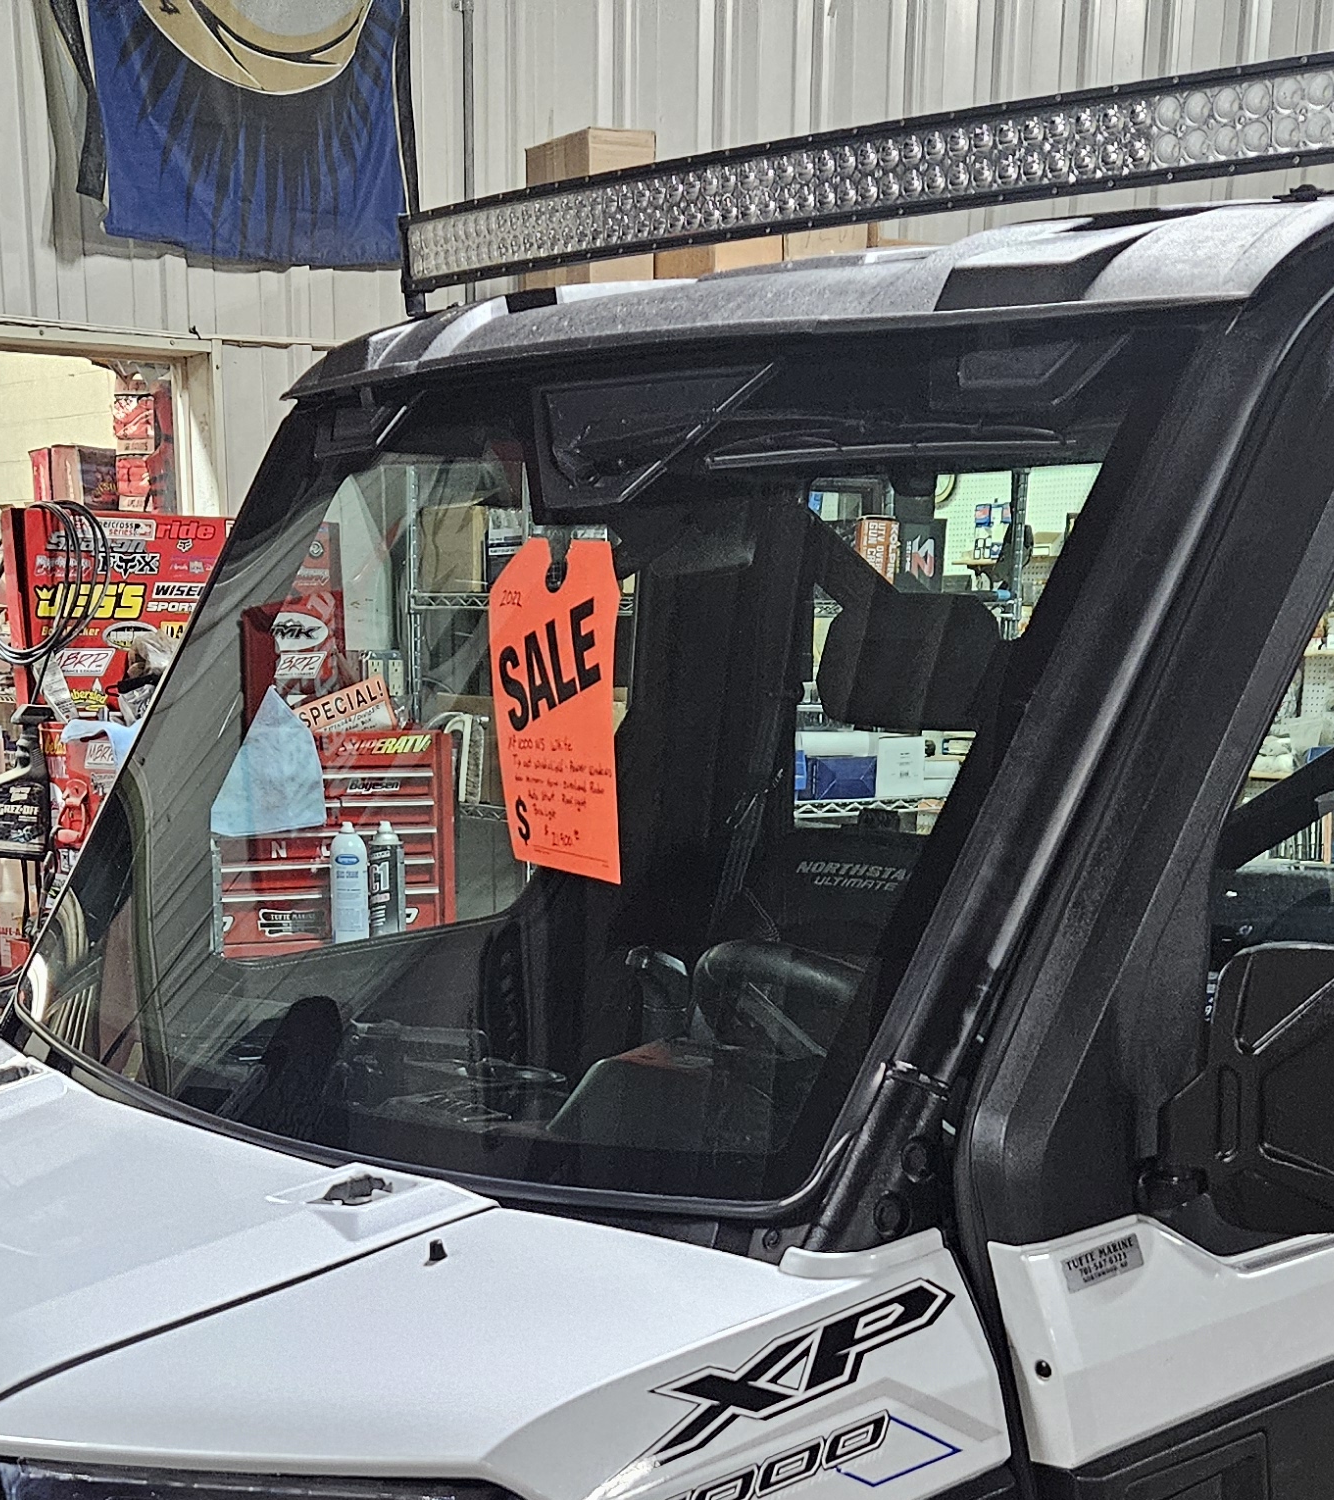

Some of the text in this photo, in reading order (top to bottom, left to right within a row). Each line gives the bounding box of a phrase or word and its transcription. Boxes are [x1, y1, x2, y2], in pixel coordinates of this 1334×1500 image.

[156, 520, 216, 540] ride
[499, 597, 602, 732] SALE
[299, 680, 385, 730] SPECIAL!
[348, 779, 400, 794] Boyesen
[516, 795, 531, 846] $
[1066, 1236, 1133, 1271] TUFTE MARINE
